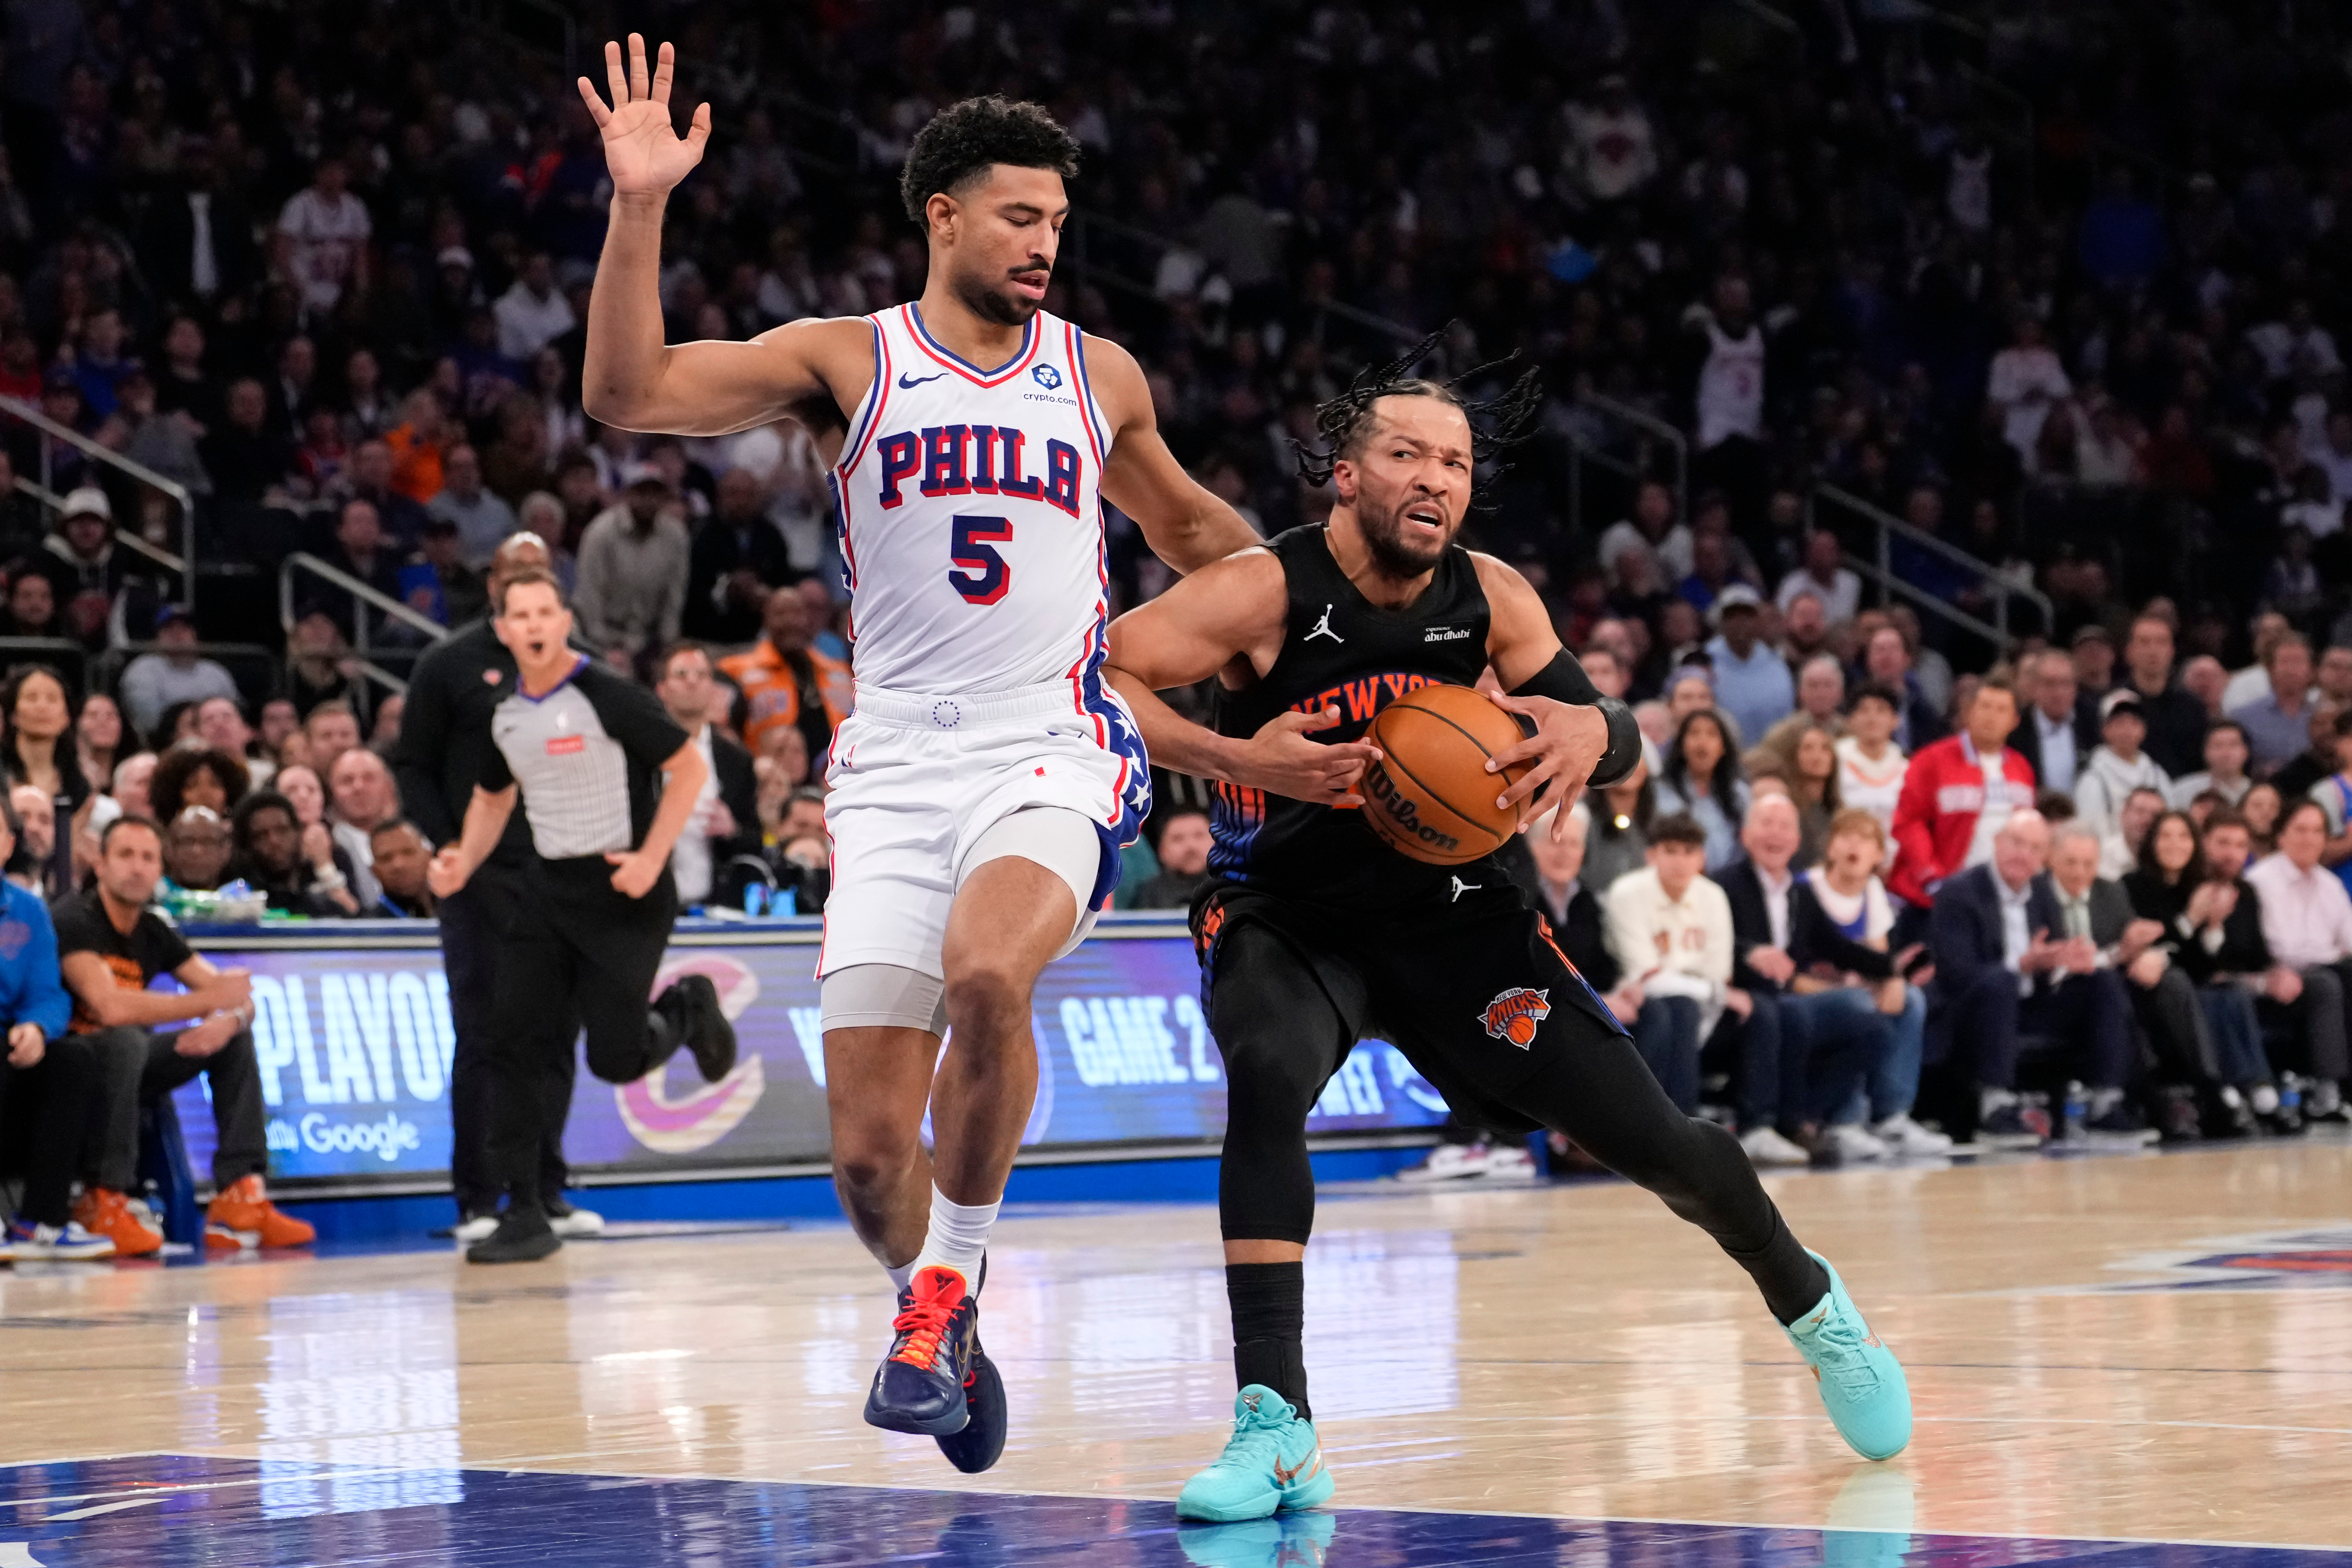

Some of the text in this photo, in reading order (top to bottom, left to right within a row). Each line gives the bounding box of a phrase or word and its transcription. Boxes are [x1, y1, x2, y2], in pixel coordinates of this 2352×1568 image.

[1023, 392, 1076, 407] crypto.com
[877, 424, 1082, 520] PHILA
[949, 515, 1013, 606] 5
[1424, 629, 1471, 642] abu dhabi
[1383, 672, 1442, 700] YO
[1367, 759, 1460, 851] Wilson
[1488, 991, 1548, 1033] KNICKS
[1496, 988, 1522, 1003] NEW YORK
[1060, 994, 1220, 1087] GAME 2
[300, 1112, 421, 1161] Google
